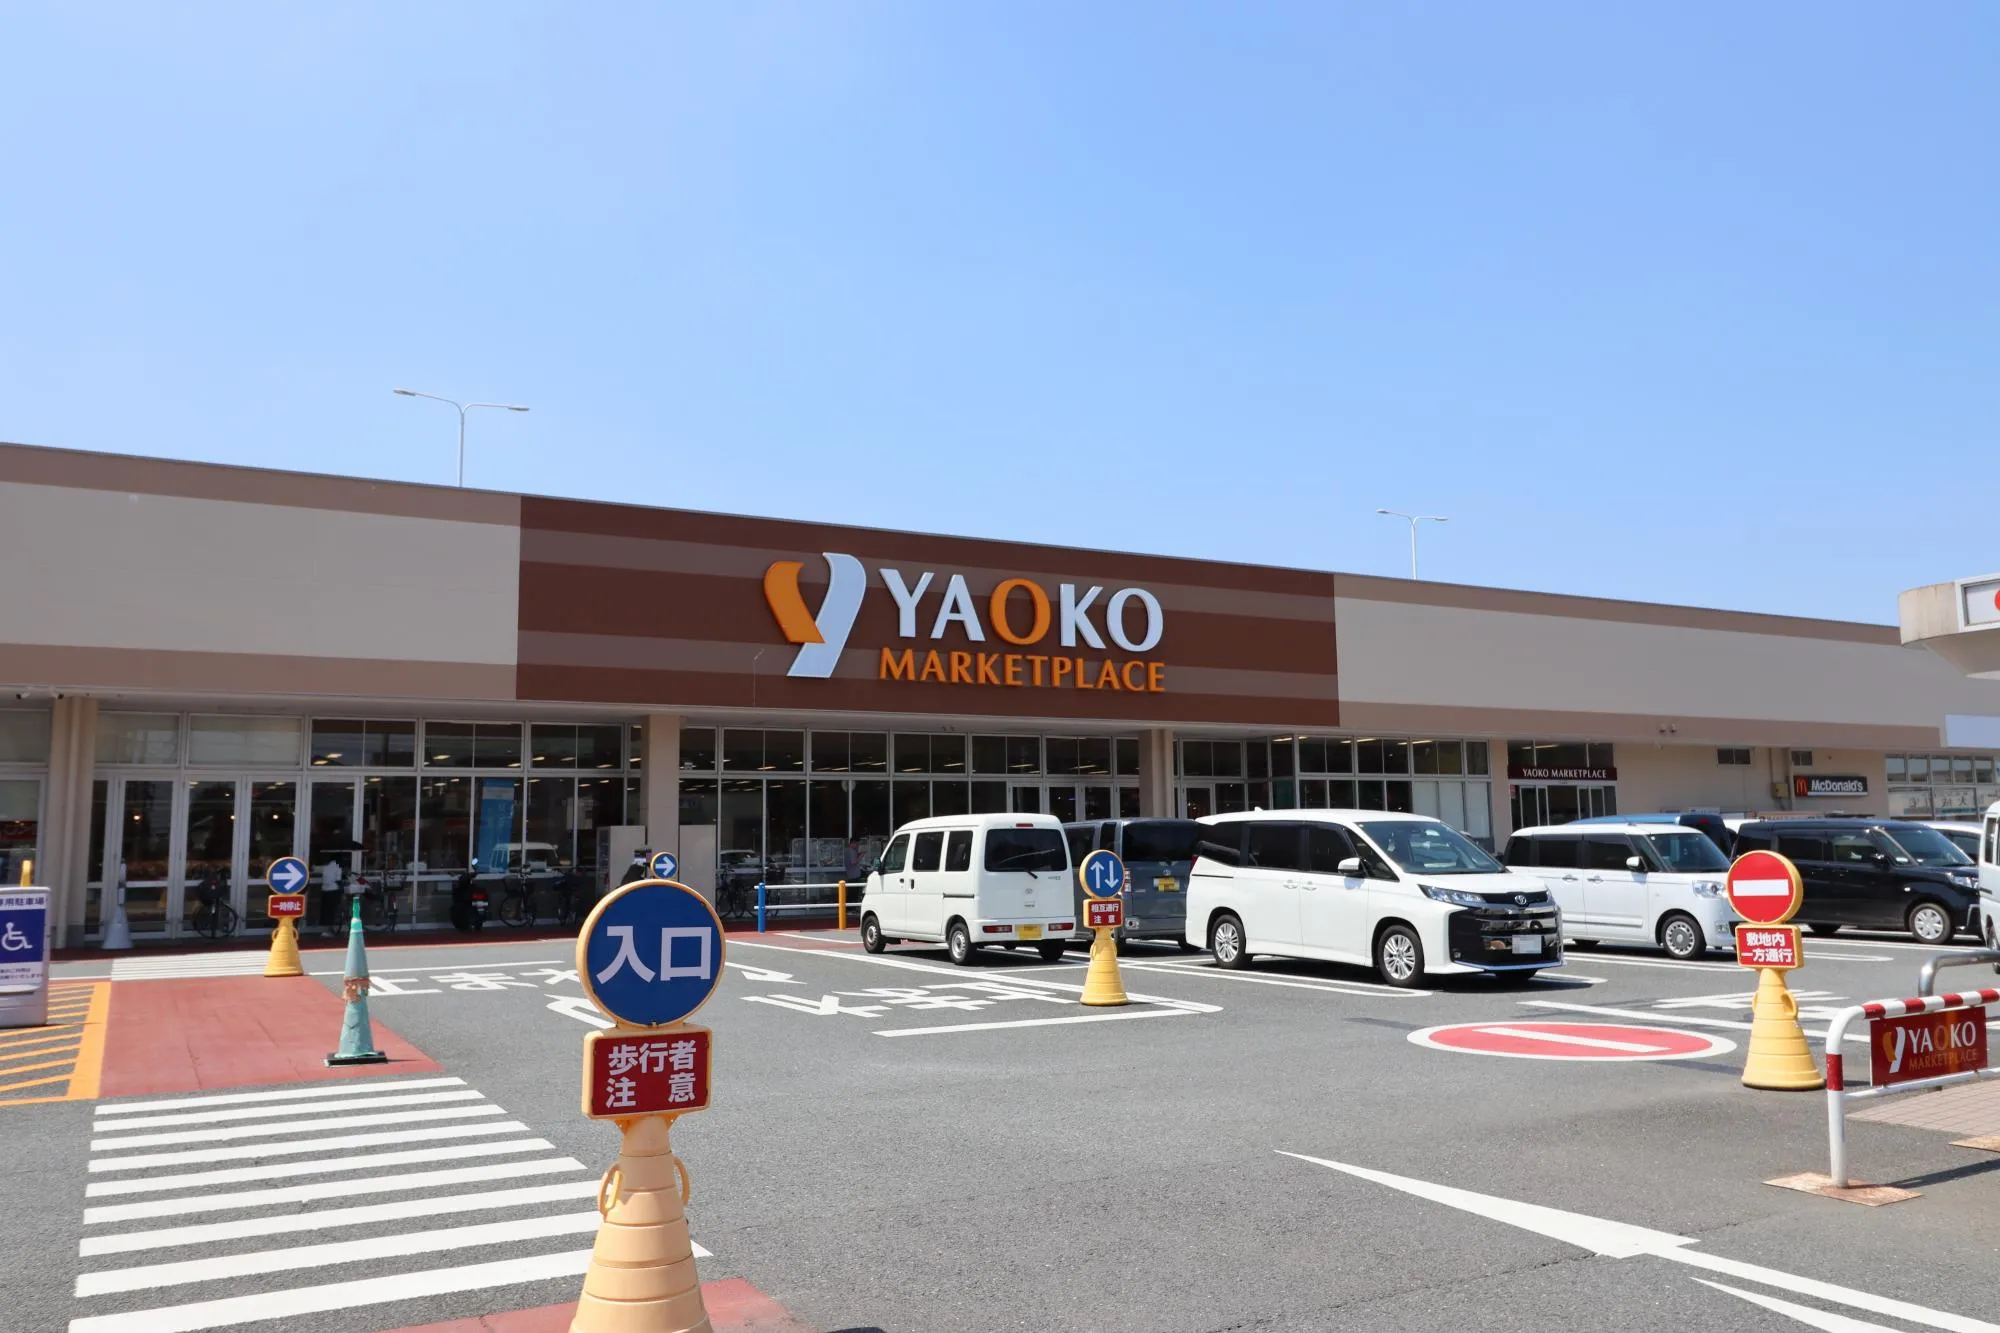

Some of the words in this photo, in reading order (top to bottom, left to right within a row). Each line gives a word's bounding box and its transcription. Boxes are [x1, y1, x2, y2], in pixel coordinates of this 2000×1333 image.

[879, 568, 1164, 652] YAOKO
[879, 647, 1166, 692] MARKETPLACE
[1522, 768, 1549, 778] YAOKO
[1551, 769, 1607, 778] MARKETPLACE
[1811, 779, 1863, 793] McDonald's
[596, 925, 712, 985] 入口
[1741, 948, 1793, 962] 一方通行
[1746, 931, 1785, 947] 敷地内
[1908, 1021, 1976, 1054] YAOKO
[608, 1039, 697, 1076] 歩行者
[1909, 1048, 1977, 1071] MARKETPLACE
[605, 1072, 696, 1109] 注意
